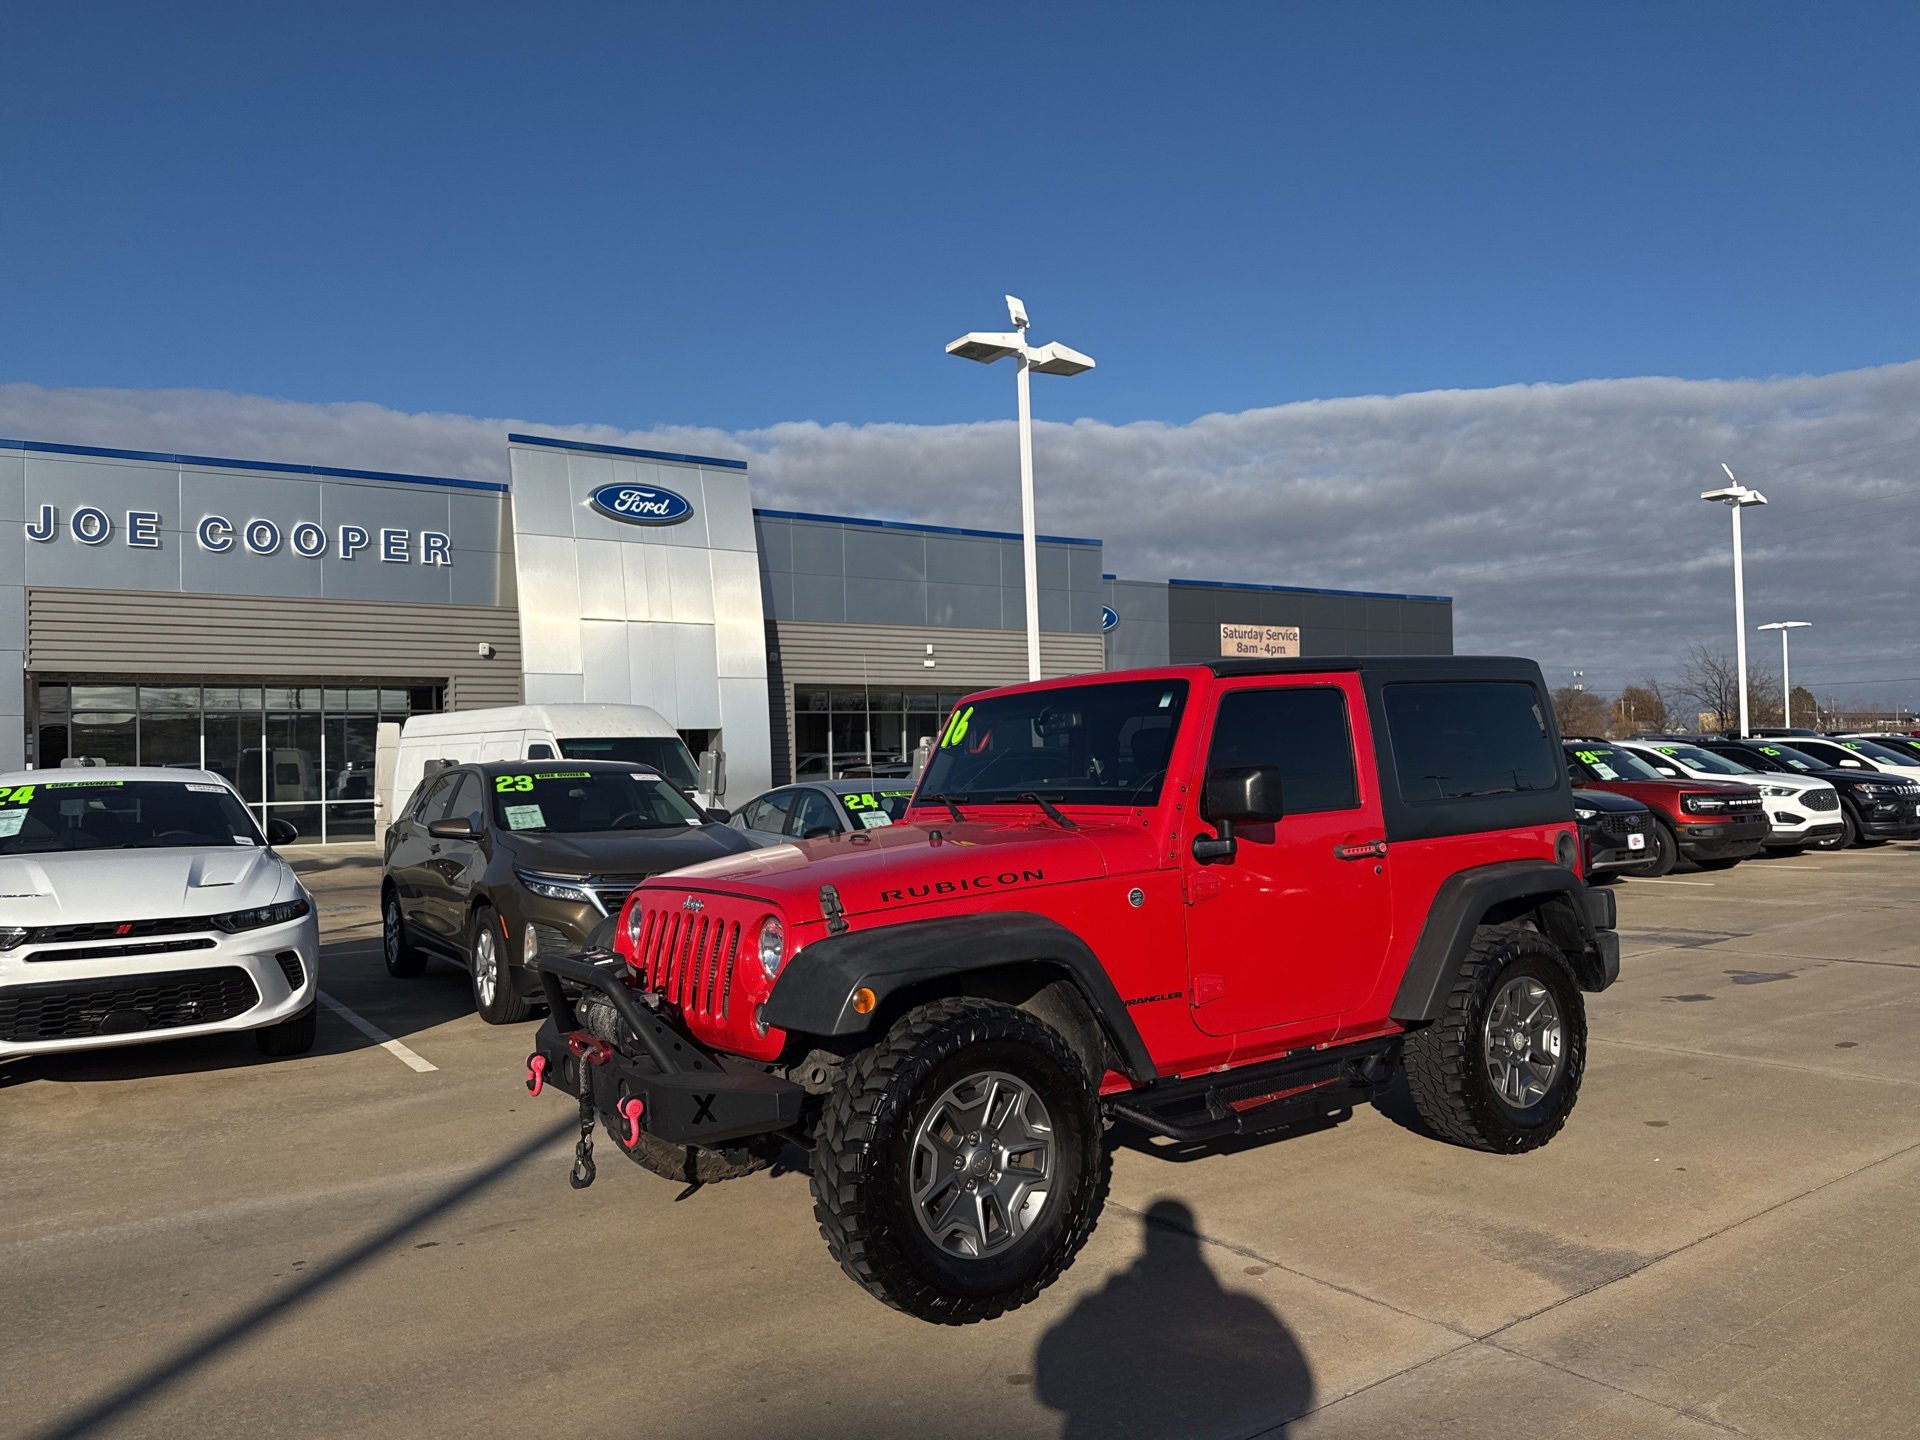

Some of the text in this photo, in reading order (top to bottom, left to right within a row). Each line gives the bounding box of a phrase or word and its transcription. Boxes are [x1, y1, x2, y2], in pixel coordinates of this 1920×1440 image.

[614, 489, 670, 515] Ford
[25, 504, 452, 565] JOE COOPER
[1222, 626, 1298, 642] Saturday Service
[940, 706, 974, 748] 16
[1575, 750, 1600, 764] 24
[495, 775, 534, 792] 23
[844, 793, 878, 810] 24
[881, 869, 1044, 902] RUBICON
